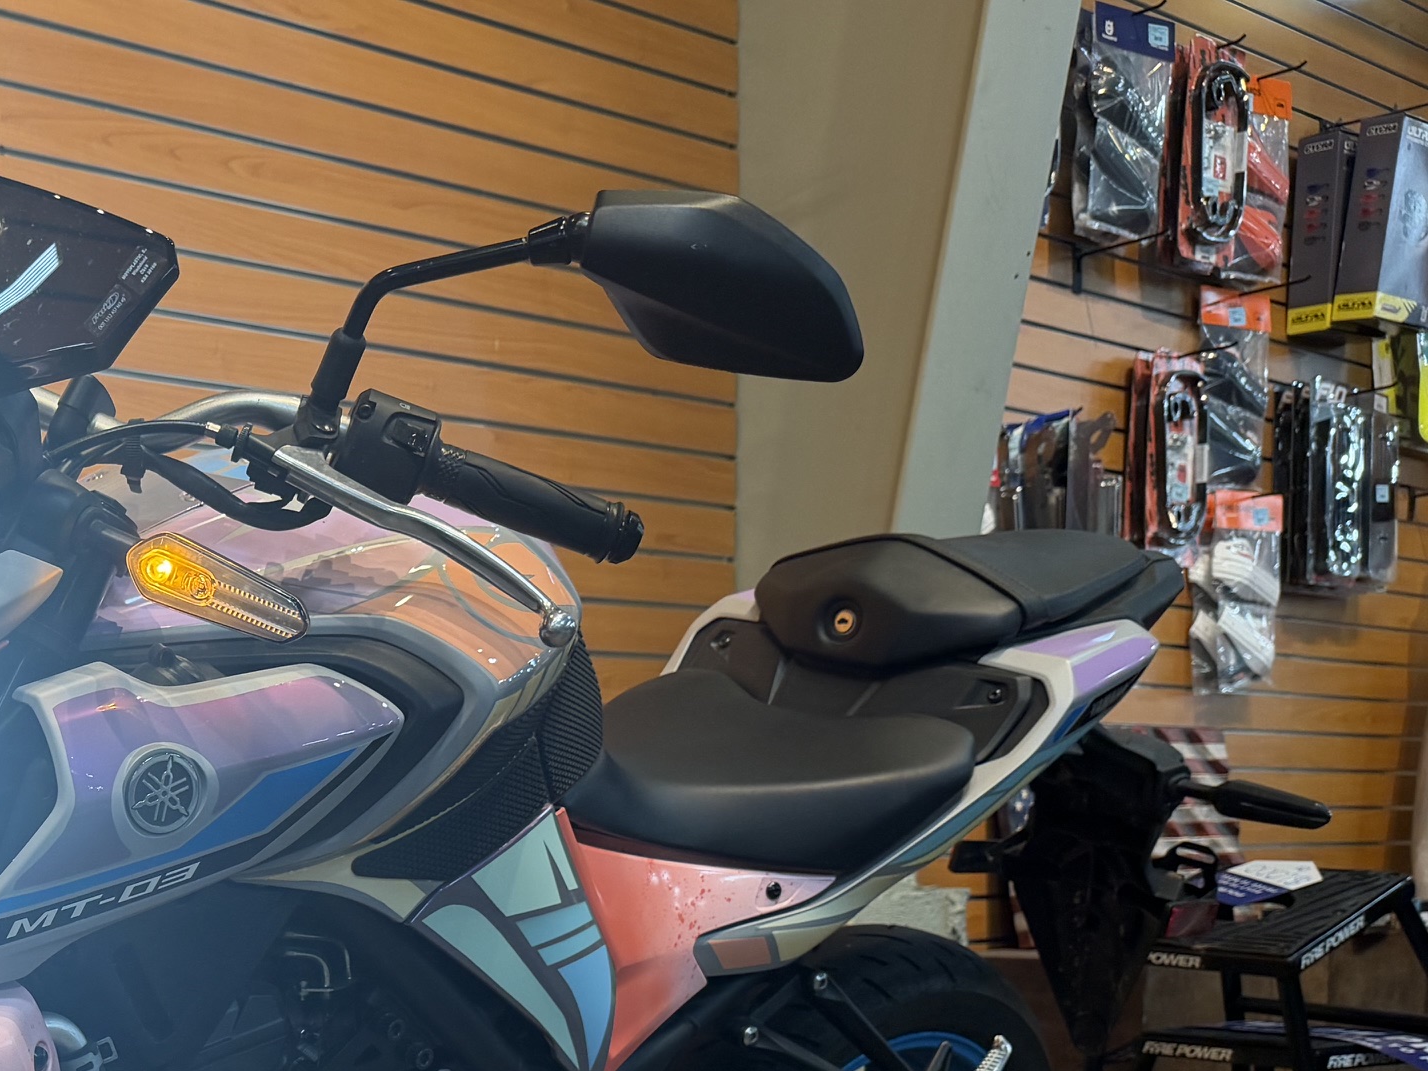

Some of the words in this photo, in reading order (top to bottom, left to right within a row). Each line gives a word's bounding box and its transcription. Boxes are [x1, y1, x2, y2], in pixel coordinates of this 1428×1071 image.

[6, 861, 201, 939] MT-03
[1325, 915, 1365, 951] POWER
[1175, 1043, 1233, 1062] POWER
